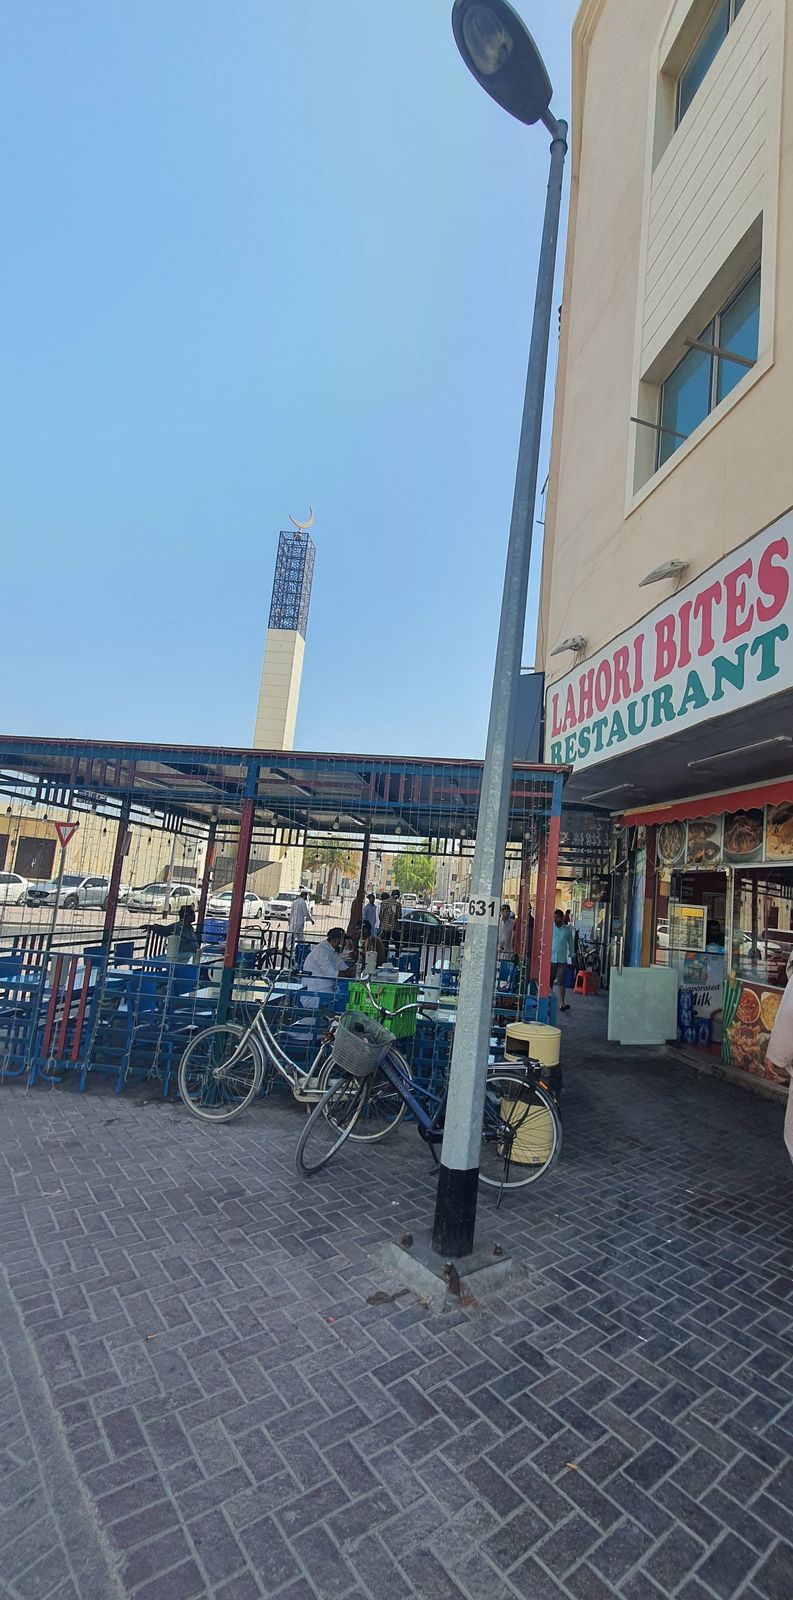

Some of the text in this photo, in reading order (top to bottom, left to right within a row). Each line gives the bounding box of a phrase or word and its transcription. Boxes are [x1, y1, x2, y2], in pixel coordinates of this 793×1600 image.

[550, 623, 789, 765] RESTAURANT
[551, 536, 789, 738] LAHORI BITES
[469, 899, 495, 917] 631
